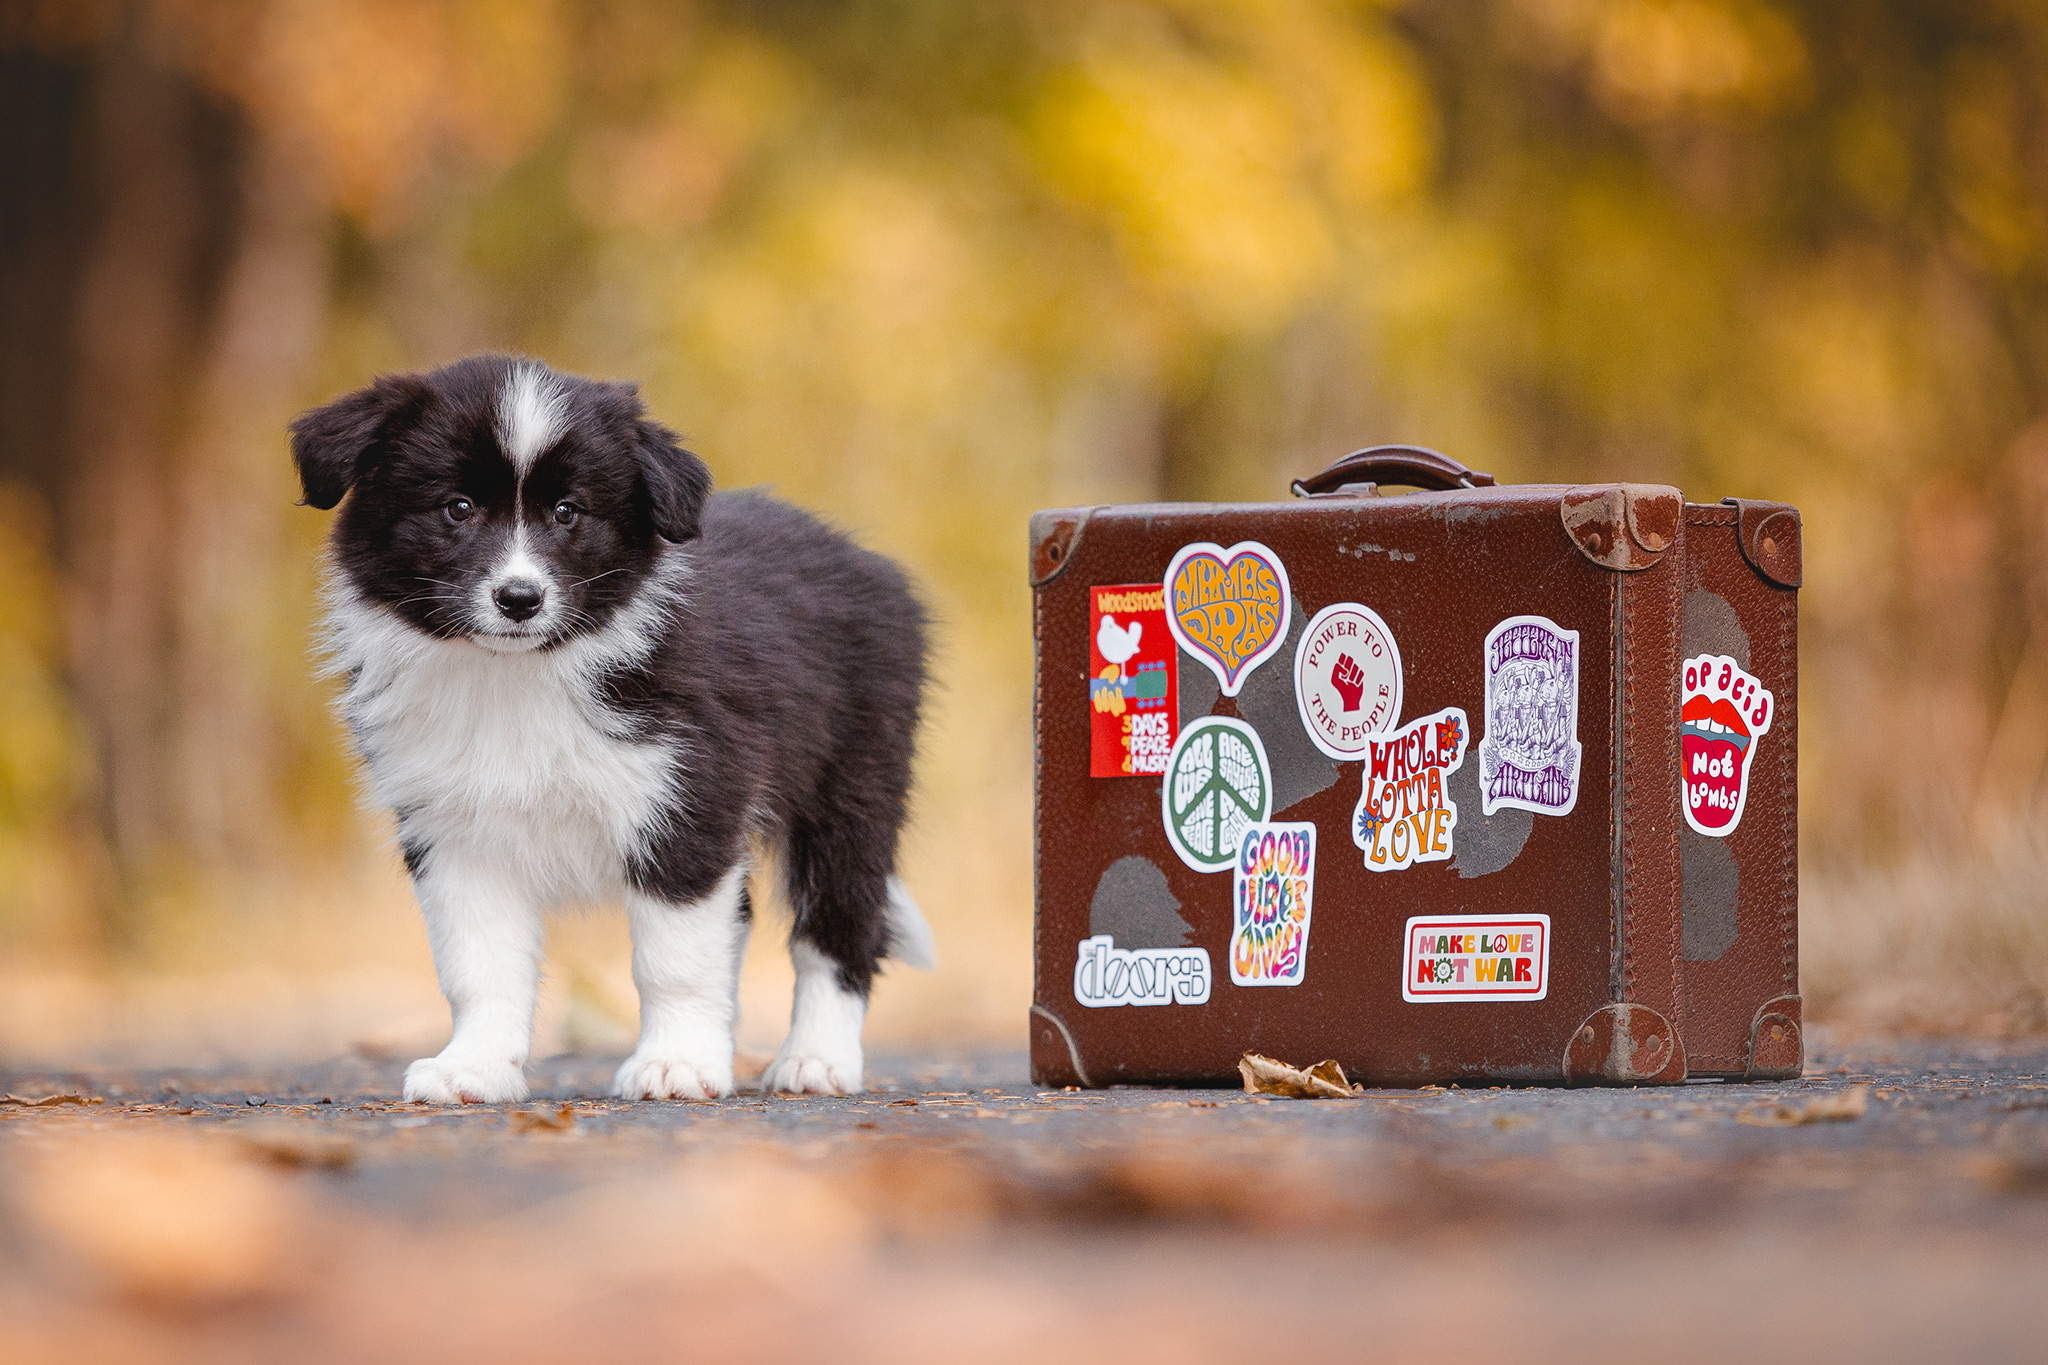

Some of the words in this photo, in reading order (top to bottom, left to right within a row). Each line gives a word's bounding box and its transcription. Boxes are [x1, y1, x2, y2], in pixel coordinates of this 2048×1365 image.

[1175, 558, 1280, 614] MAMAS
[1309, 621, 1358, 669] POWER
[1363, 629, 1383, 658] TO
[1490, 625, 1574, 674] JEFFERSON
[1312, 693, 1337, 736] THE
[1341, 684, 1389, 741] PEOPLE
[1717, 663, 1768, 727] acid
[1121, 715, 1132, 733] 3
[1131, 712, 1169, 736] DAYS
[1130, 734, 1171, 756] PEACE
[1178, 732, 1213, 773] ALL
[1218, 731, 1254, 768] ARE
[1369, 722, 1450, 781] WHOLE
[1692, 749, 1734, 779] Not
[1174, 768, 1213, 815] WE
[1219, 789, 1236, 820] A
[1365, 767, 1443, 823] LOTTA
[1488, 762, 1571, 806] AIRPLANE
[1180, 818, 1214, 857] PEACE
[1240, 830, 1310, 877] GOOD
[1370, 808, 1451, 865] LOVE
[1239, 872, 1308, 927] VIBES
[1235, 922, 1302, 979] ONLY
[1419, 935, 1475, 954] MAKE
[1481, 934, 1534, 953] LOVE
[1080, 944, 1205, 998] doors
[1417, 957, 1469, 984] NOT
[1475, 957, 1532, 982] WAR
